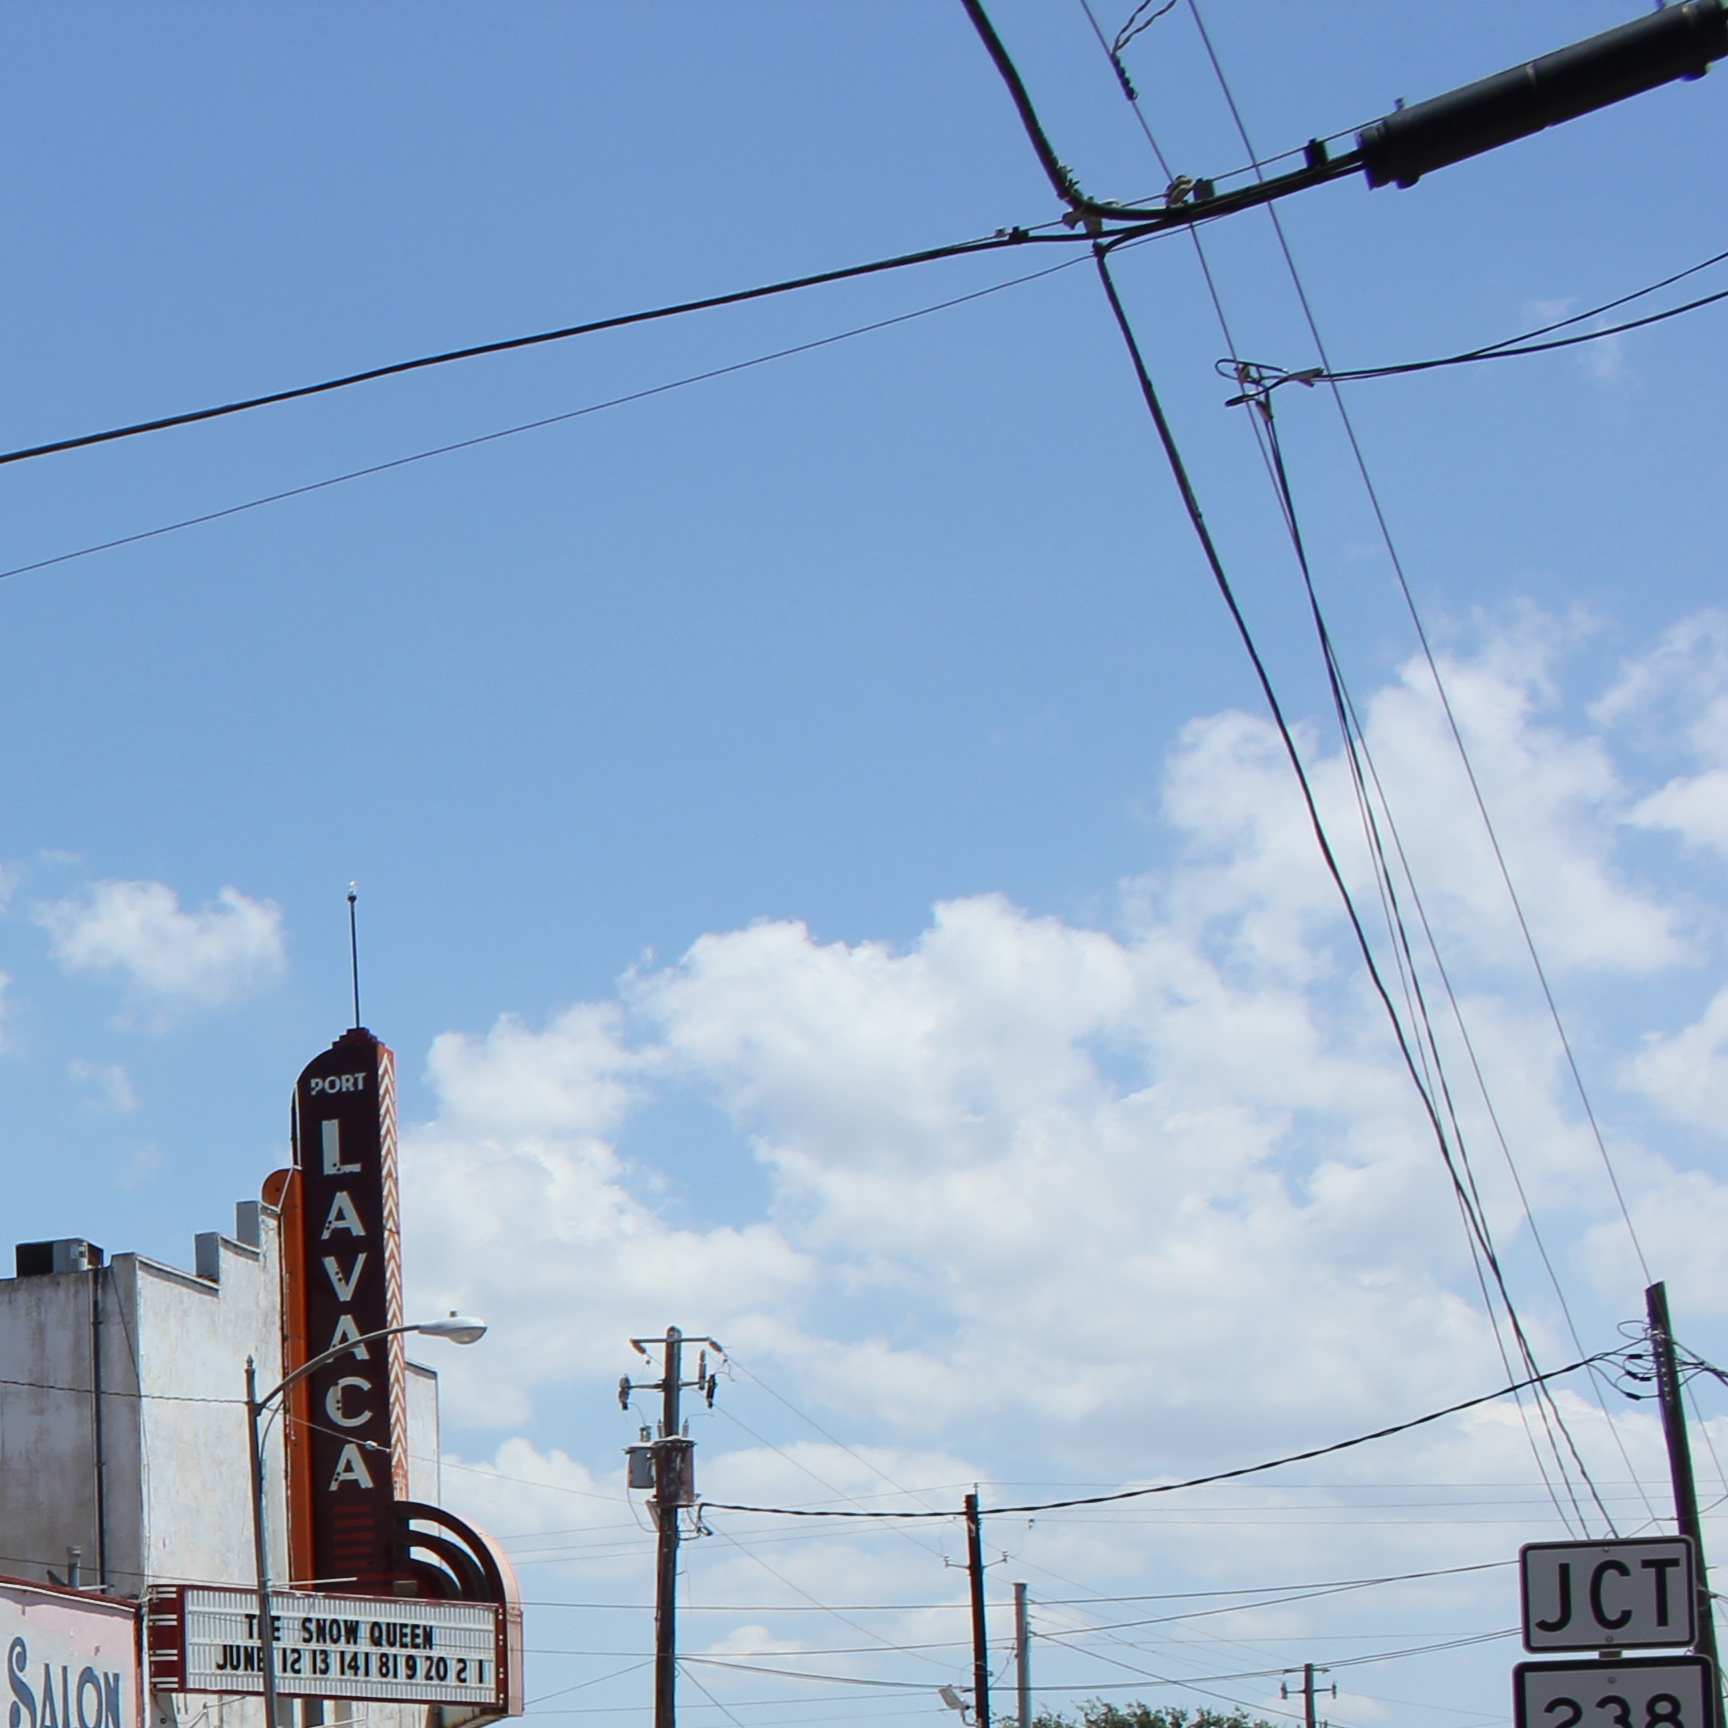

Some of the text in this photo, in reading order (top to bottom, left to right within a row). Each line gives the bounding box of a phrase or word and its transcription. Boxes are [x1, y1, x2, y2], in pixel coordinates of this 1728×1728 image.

[310, 1072, 367, 1096] PORT
[320, 1118, 374, 1492] LAVACA
[1534, 1557, 1681, 1632] JCT
[301, 1617, 359, 1645] SNOW
[369, 1621, 433, 1650] QUEEN
[282, 1648, 301, 1674] 12
[312, 1650, 329, 1675] 13
[425, 1655, 448, 1681] 20
